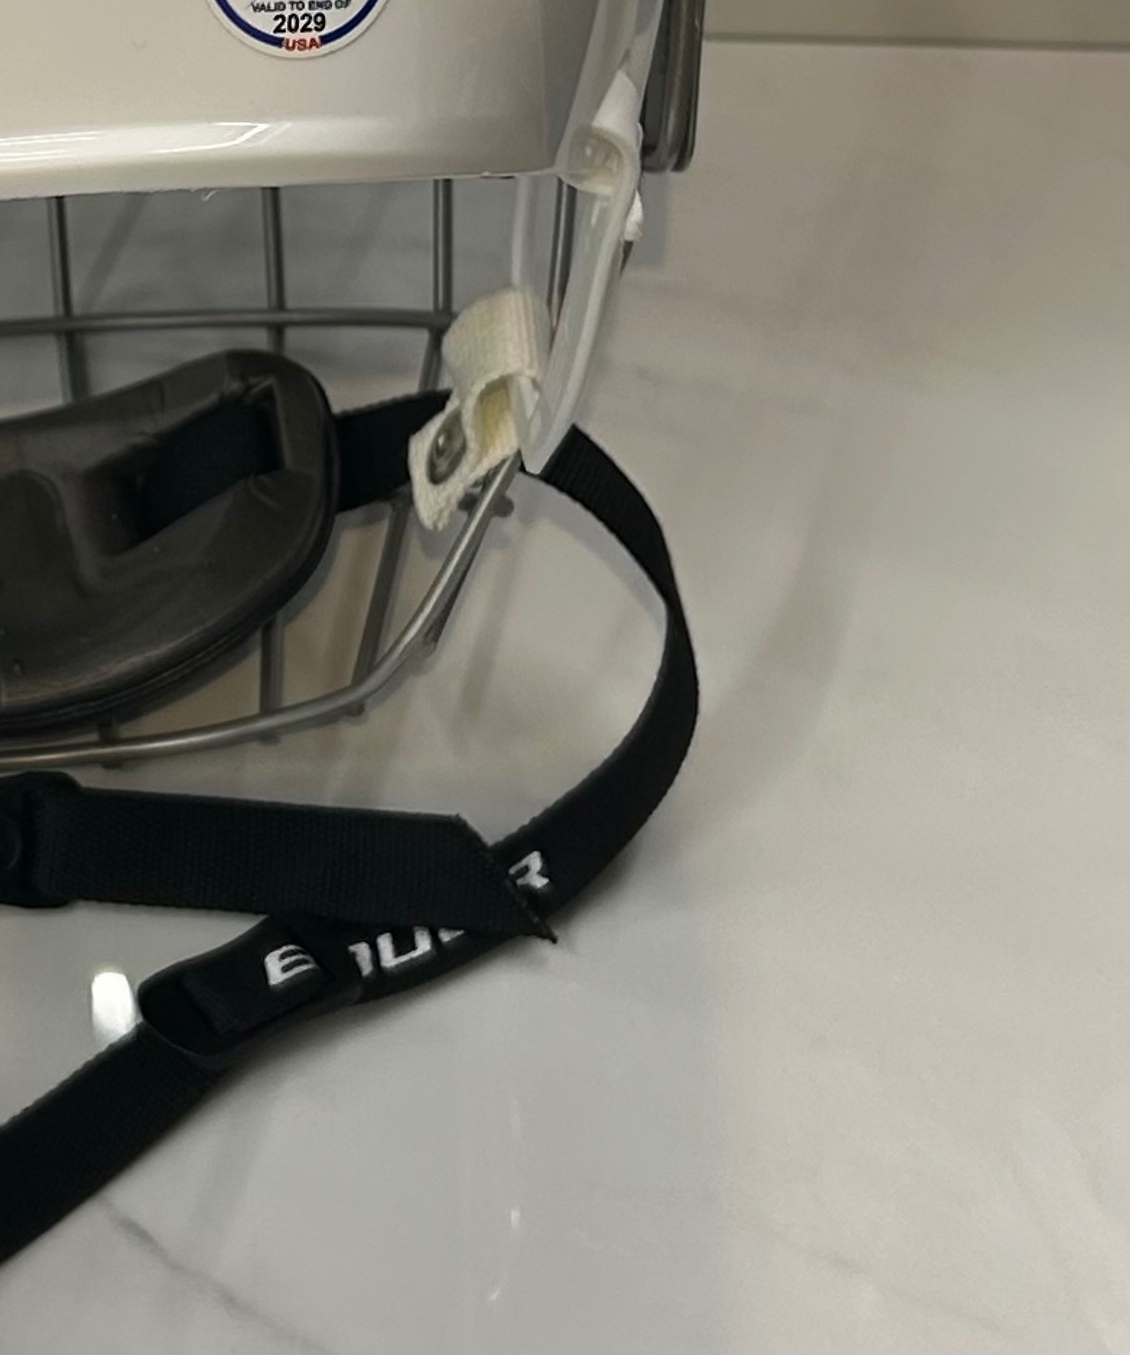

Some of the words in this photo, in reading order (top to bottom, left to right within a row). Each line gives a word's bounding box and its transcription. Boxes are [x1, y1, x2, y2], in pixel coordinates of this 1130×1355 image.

[251, 0, 286, 13] VALID
[289, 0, 305, 11] TO
[308, 0, 333, 11] END
[273, 12, 326, 34] 2029
[285, 37, 320, 52] USA
